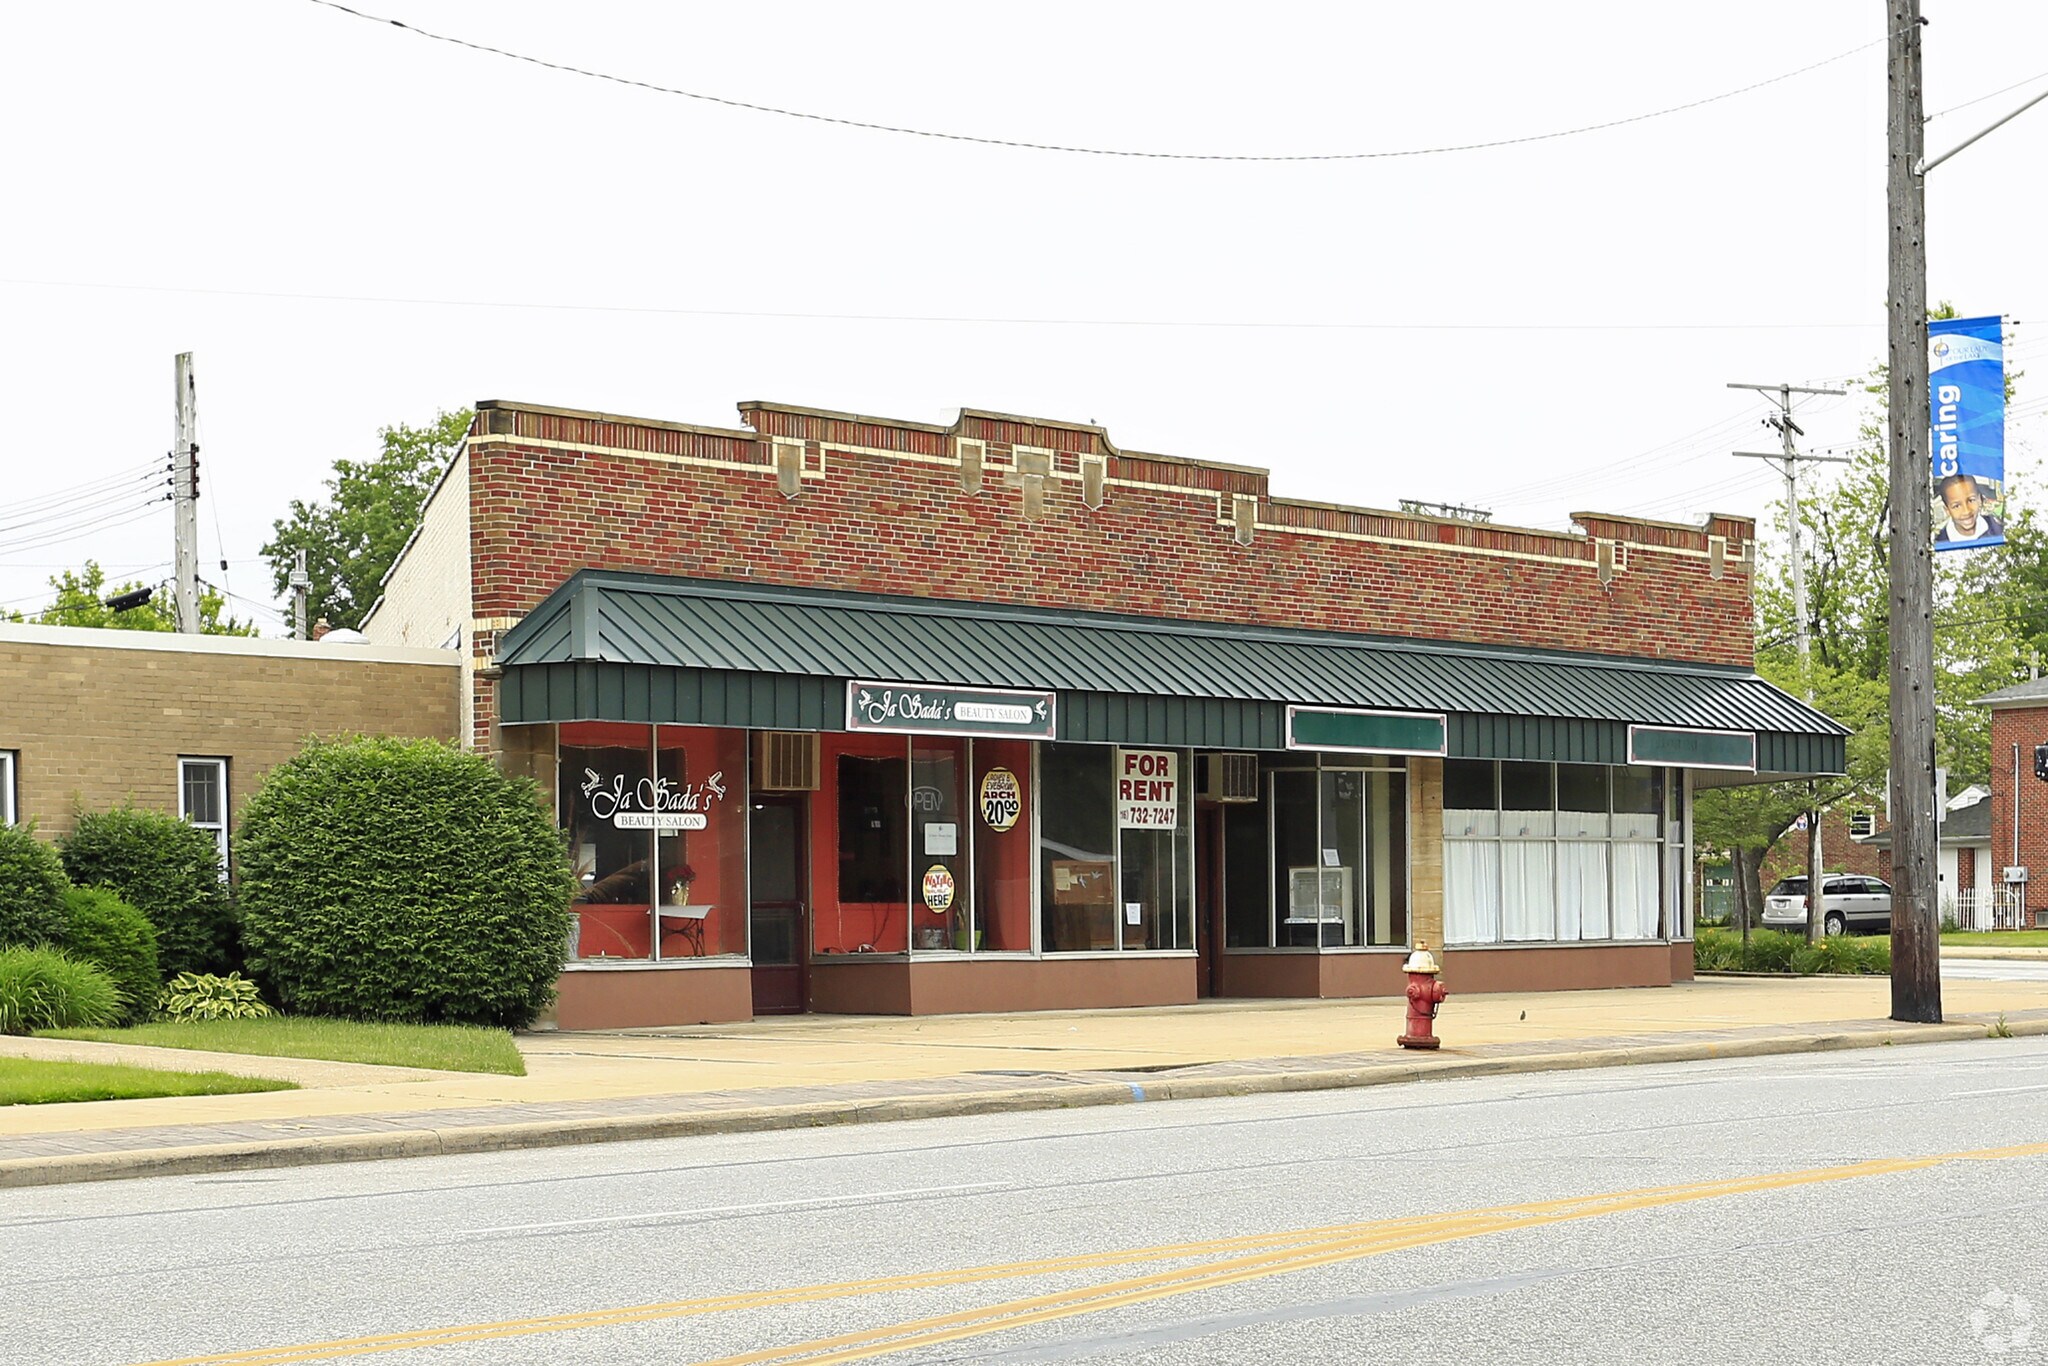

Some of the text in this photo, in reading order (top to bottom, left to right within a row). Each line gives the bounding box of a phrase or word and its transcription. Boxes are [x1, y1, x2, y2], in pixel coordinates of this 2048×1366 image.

[1933, 384, 1961, 477] caring
[868, 690, 1028, 723] Ja Sada's BEAUTY SALON
[1125, 754, 1169, 777] FOR
[592, 774, 712, 819] Ja Sada's
[983, 791, 1016, 799] ARCH
[1119, 779, 1174, 802] RENT
[620, 815, 701, 827] BEAUTY SALON
[1130, 807, 1175, 825] 732-7247
